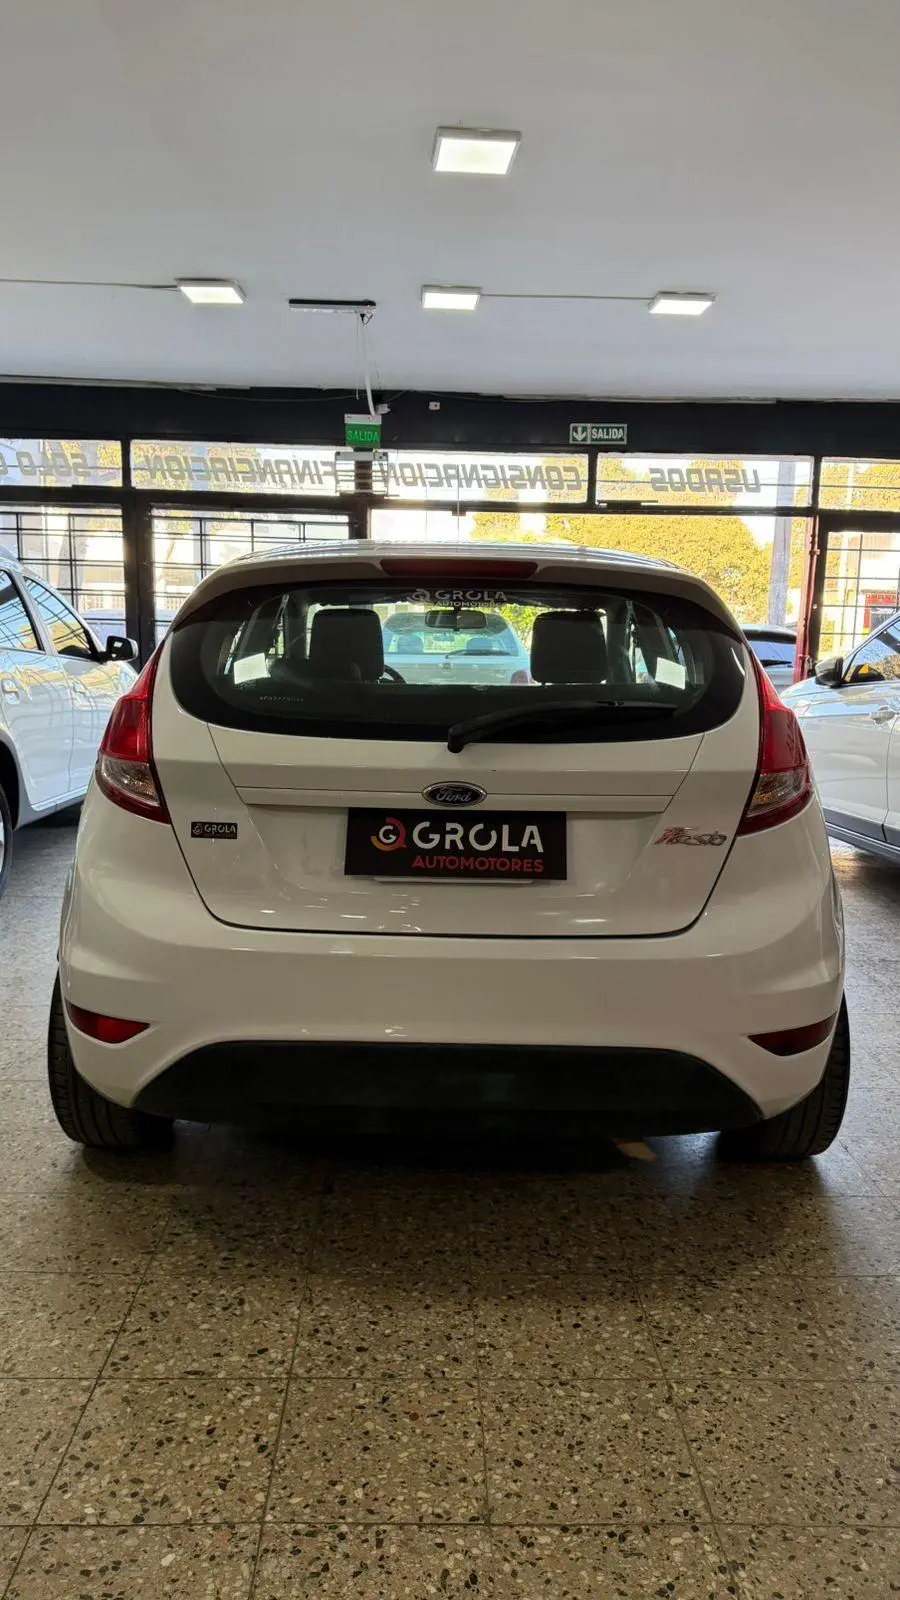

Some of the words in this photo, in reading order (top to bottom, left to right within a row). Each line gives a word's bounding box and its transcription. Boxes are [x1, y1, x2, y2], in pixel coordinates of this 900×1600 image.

[346, 430, 380, 442] SALIDA
[591, 427, 624, 439] SALIDA
[434, 590, 507, 601] GROLA
[435, 786, 472, 802] Ford
[204, 824, 236, 833] GROLA
[412, 821, 544, 853] GROLA
[411, 855, 544, 873] AUTOMOTORES
